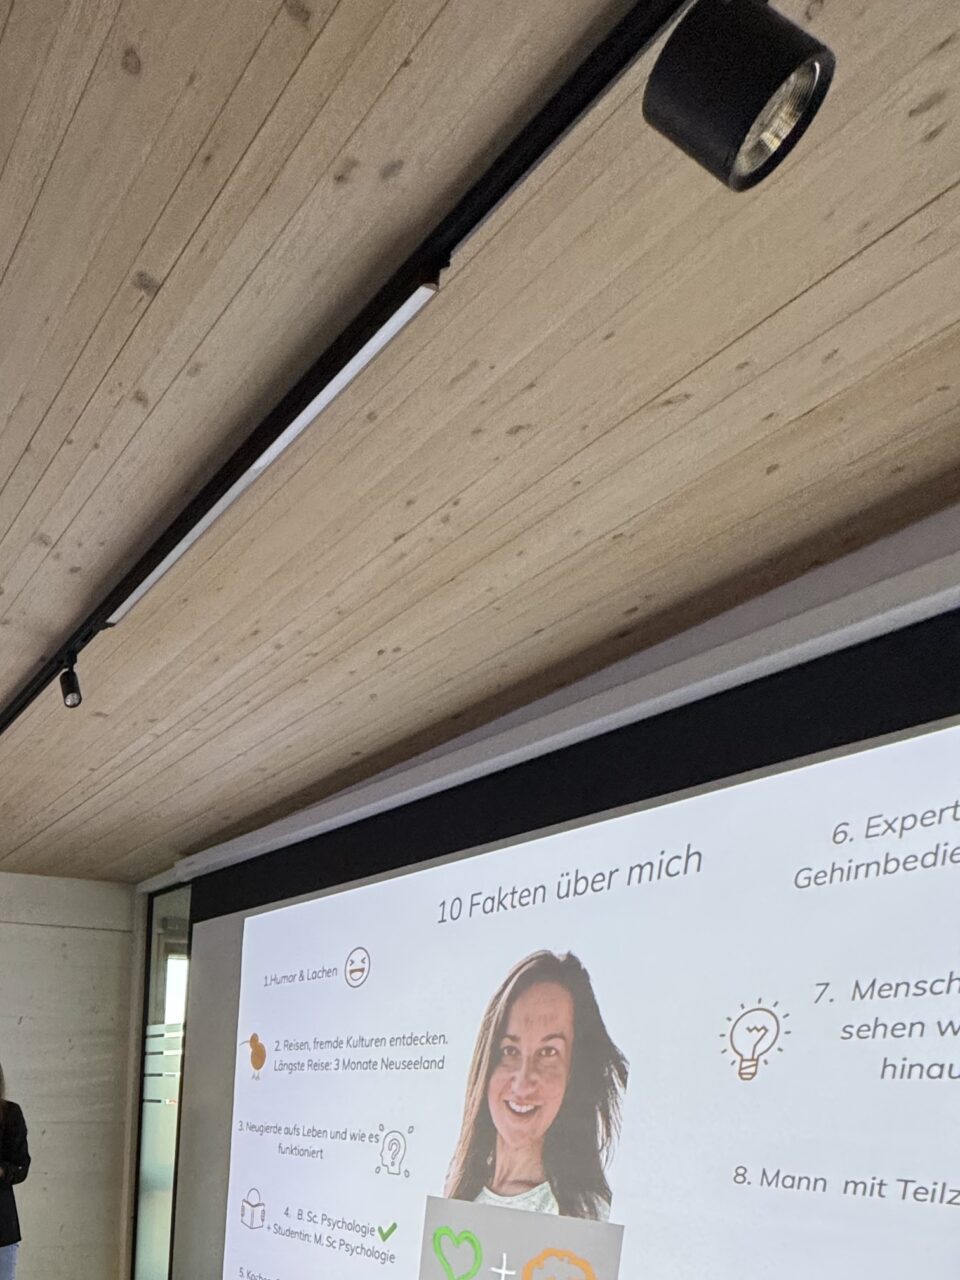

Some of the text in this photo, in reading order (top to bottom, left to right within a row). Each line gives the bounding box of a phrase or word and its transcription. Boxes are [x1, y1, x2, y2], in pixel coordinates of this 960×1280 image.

[832, 799, 960, 845] 6. Expert
[437, 843, 703, 924] 10 Fakten über mich
[306, 964, 338, 981] Lachen
[813, 971, 960, 1004] 7. Mensch
[840, 1017, 925, 1040] sehen
[283, 1037, 311, 1053] Reisen,
[312, 1036, 344, 1051] fremde
[346, 1033, 387, 1049] Kulturen
[389, 1031, 449, 1047] entdecken.
[273, 1056, 445, 1075] Längste Reise: 3 Monate Neuseeland
[245, 1121, 282, 1136] Neugierde
[283, 1123, 301, 1137] aufs
[302, 1124, 328, 1140] Leben
[329, 1126, 347, 1141] und
[349, 1129, 366, 1142] wie
[367, 1131, 380, 1144] es
[278, 1142, 324, 1159] funktioniert
[732, 1165, 960, 1206] 8. Mann mit Teilz
[320, 1213, 376, 1238] Psychologie
[313, 1232, 325, 1247] M.
[338, 1239, 396, 1265] Psychologie
